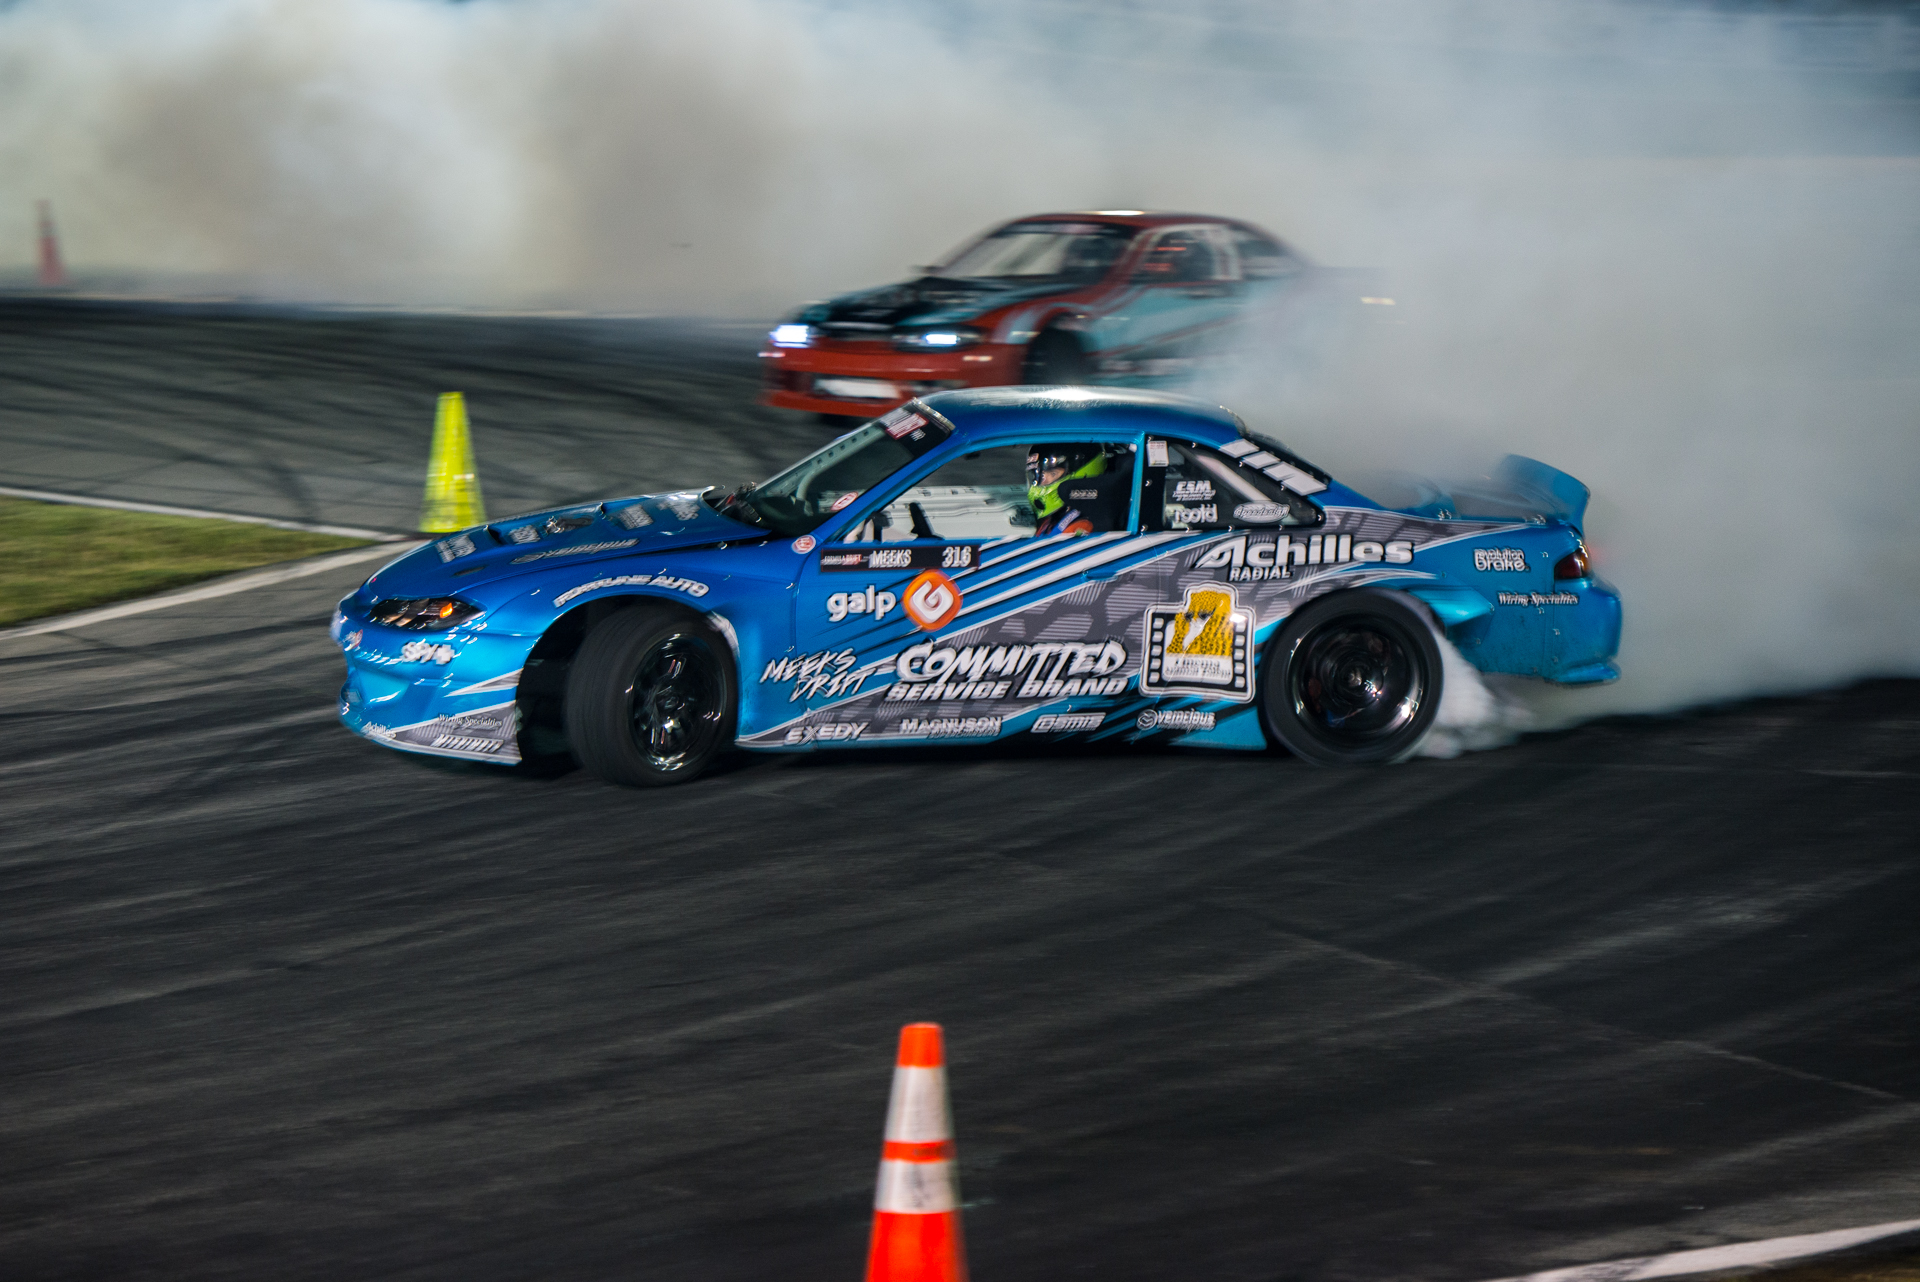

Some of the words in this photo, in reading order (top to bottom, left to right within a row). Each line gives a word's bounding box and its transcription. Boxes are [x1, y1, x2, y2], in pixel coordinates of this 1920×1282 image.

[869, 549, 912, 569] MEEKS
[941, 546, 972, 568] 316
[1195, 535, 1412, 567] Achilles
[1474, 547, 1525, 560] revolution
[1229, 565, 1292, 582] RADIAL
[1474, 556, 1526, 572] brake
[553, 574, 653, 607] FORTUNE
[648, 575, 710, 597] AUTO
[1498, 591, 1529, 607] Wiring
[1530, 591, 1579, 607] Specialties
[826, 584, 896, 622] galp
[759, 647, 856, 684] MEEKS
[789, 667, 876, 702] DRIFT
[886, 681, 1012, 701] SERVICE
[1017, 677, 1128, 698] BRAND
[784, 721, 868, 746] EXEDY
[901, 717, 1002, 734] MAGNUSON
